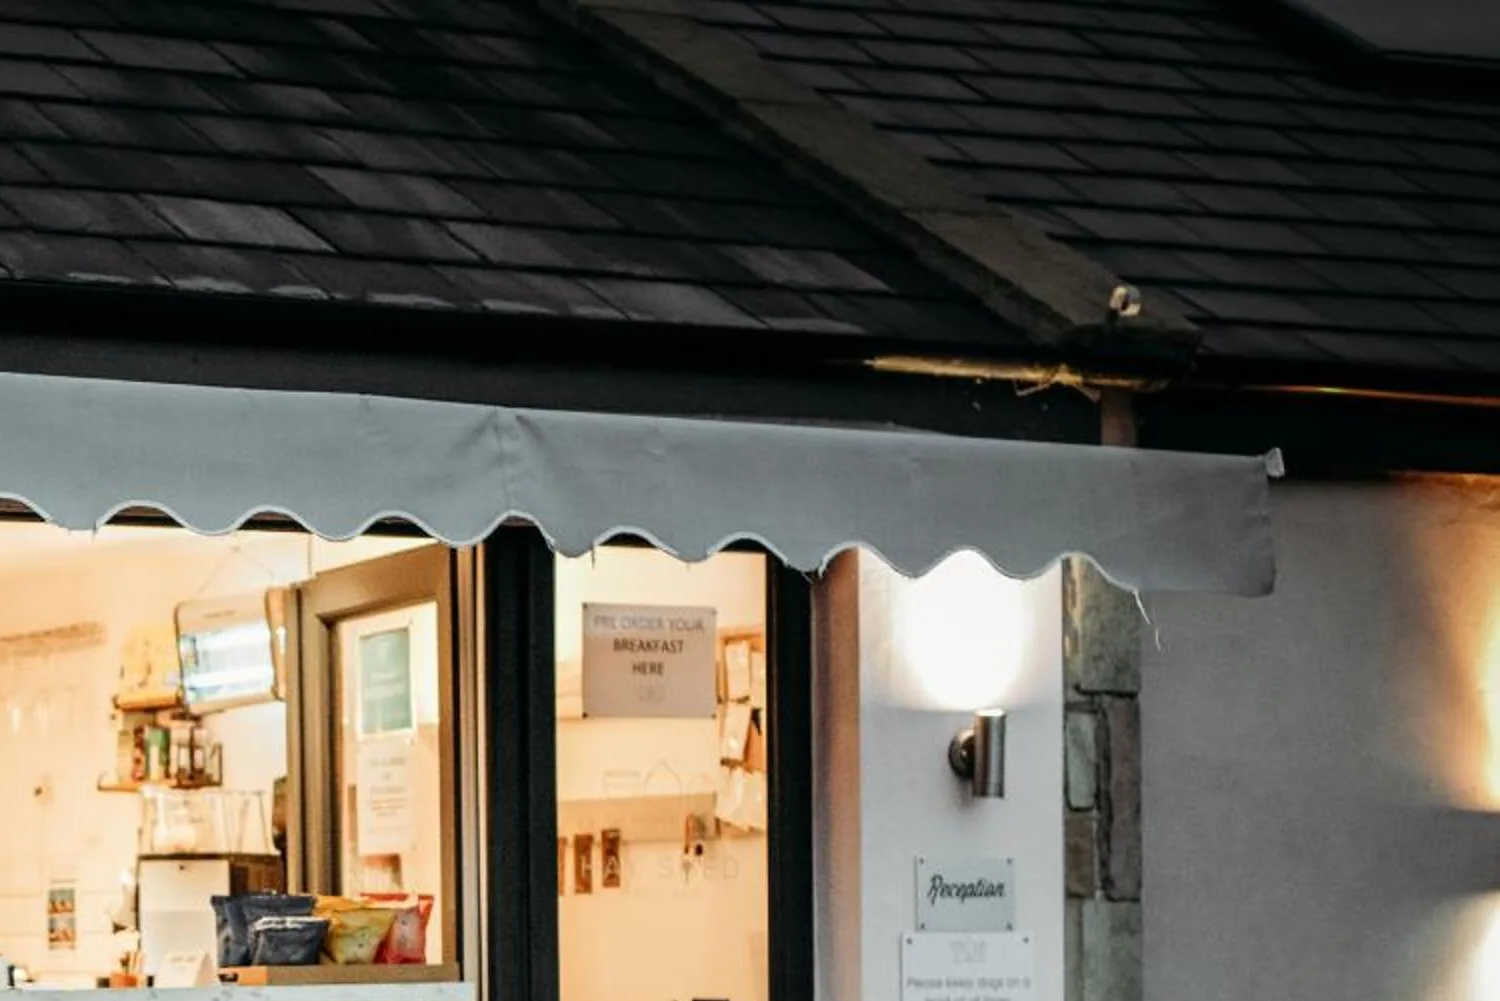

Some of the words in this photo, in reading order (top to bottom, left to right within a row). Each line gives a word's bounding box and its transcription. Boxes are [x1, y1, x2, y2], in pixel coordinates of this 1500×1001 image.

[613, 638, 684, 654] BREAKFAST
[631, 660, 664, 677] HERE
[927, 872, 1006, 907] Reception
[906, 976, 943, 990] Please
[977, 976, 1004, 992] dogs
